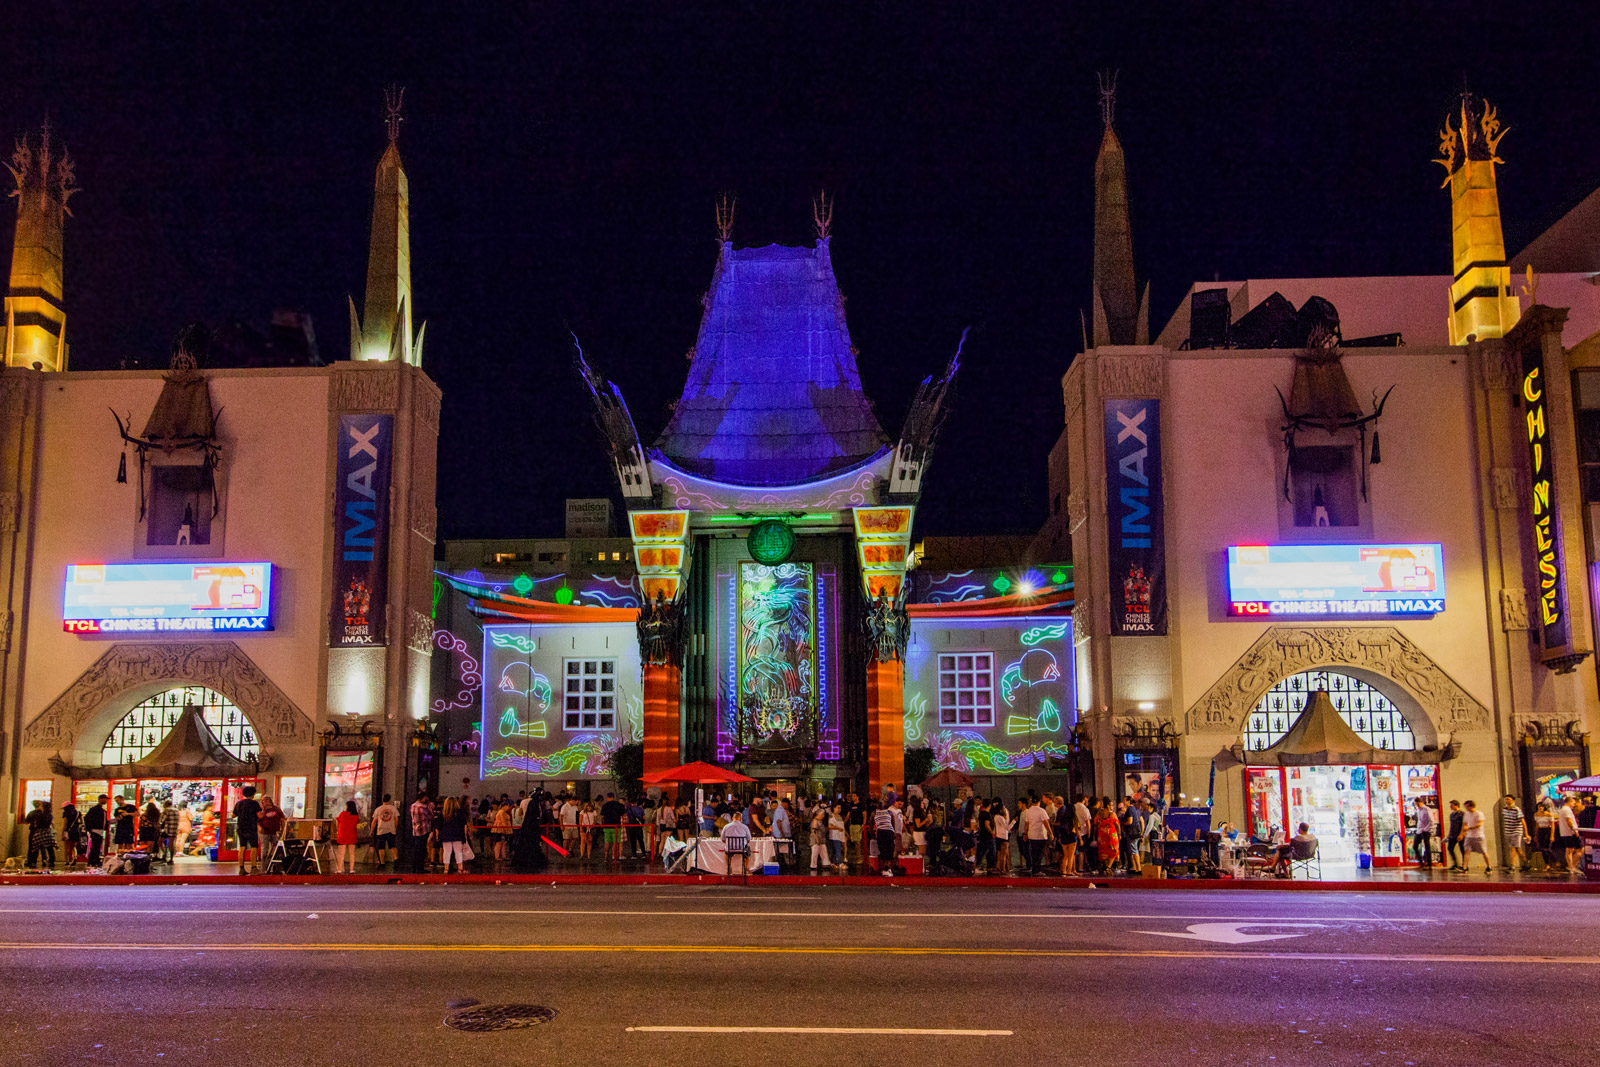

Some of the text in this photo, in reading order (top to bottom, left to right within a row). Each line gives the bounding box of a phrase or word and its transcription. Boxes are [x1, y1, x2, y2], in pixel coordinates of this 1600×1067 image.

[1116, 407, 1151, 548] IMAX
[344, 422, 379, 561] IMAX
[1523, 367, 1558, 626] CHINESE
[568, 503, 606, 512] madison
[1125, 605, 1150, 613] TCL
[1233, 599, 1443, 613] TCL CHINESE THEATRE IMAX
[64, 617, 266, 631] TCL CHINESE THEATRE IMAX
[344, 617, 369, 625] TCL
[341, 635, 373, 643] IMAX
